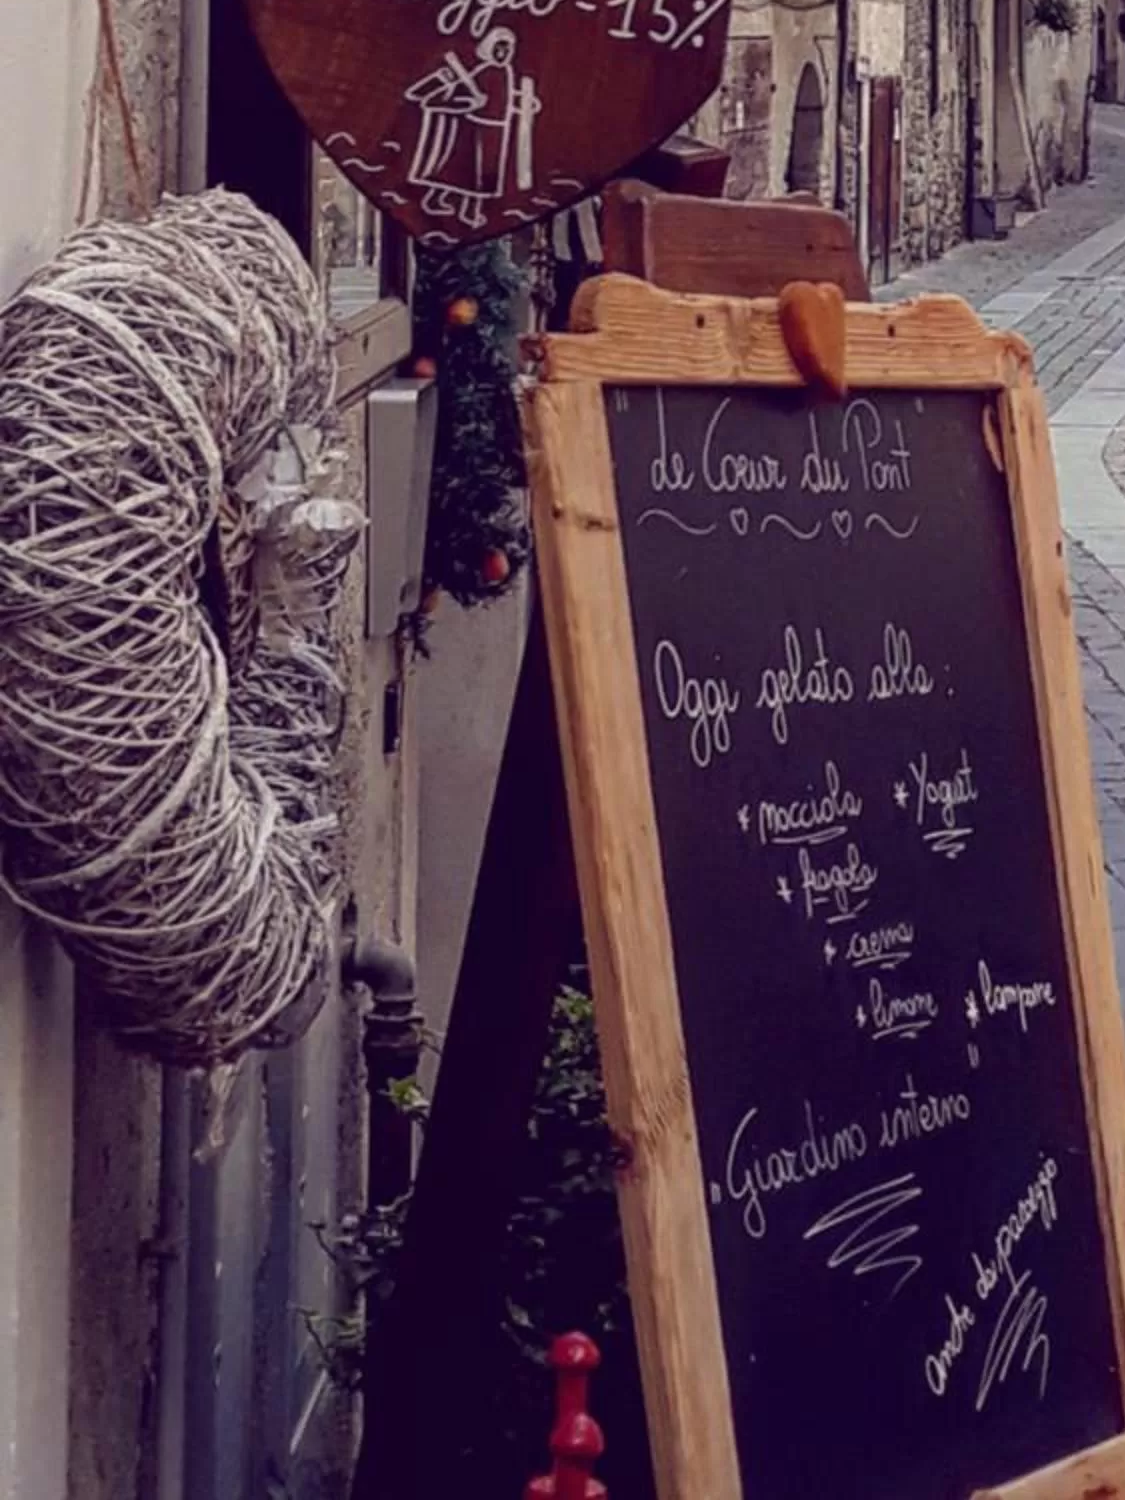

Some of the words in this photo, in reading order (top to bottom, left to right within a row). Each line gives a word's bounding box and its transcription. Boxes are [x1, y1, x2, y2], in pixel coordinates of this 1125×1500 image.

[800, 410, 850, 494] du
[654, 638, 741, 768] Oggi
[755, 624, 854, 745] gelato
[798, 841, 880, 920] fragola
[868, 976, 940, 1030] limone
[726, 1099, 868, 1239] Giardino
[879, 1072, 972, 1149] interno
